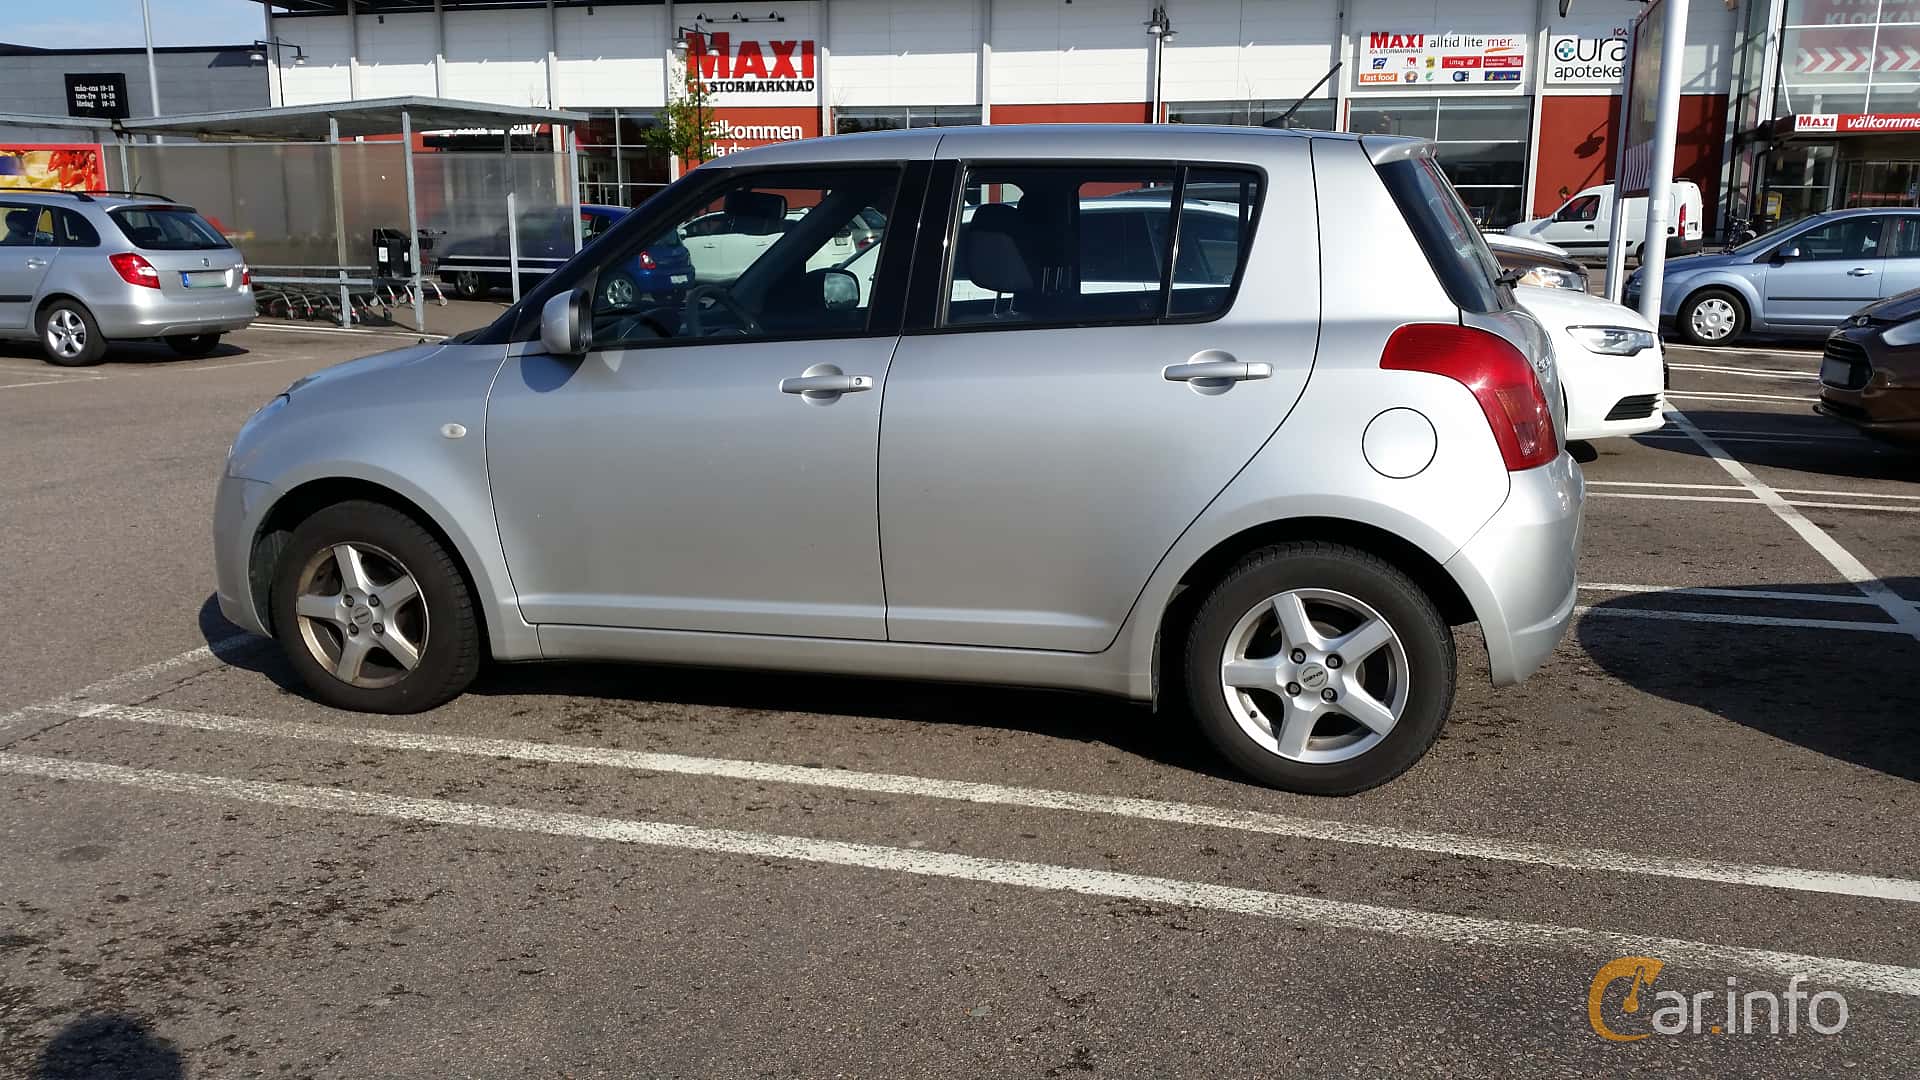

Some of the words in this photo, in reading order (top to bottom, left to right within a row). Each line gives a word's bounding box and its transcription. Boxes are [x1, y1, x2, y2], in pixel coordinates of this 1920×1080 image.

[1370, 32, 1424, 48] MAXI
[1430, 35, 1460, 48] alltid
[1464, 35, 1483, 47] lite
[685, 32, 815, 78] MAXI
[1363, 73, 1377, 81] fast
[1378, 72, 1395, 81] food
[710, 80, 815, 92] STORMARKNAD
[1798, 116, 1835, 127] MAXI
[1846, 116, 1920, 129] välkomme
